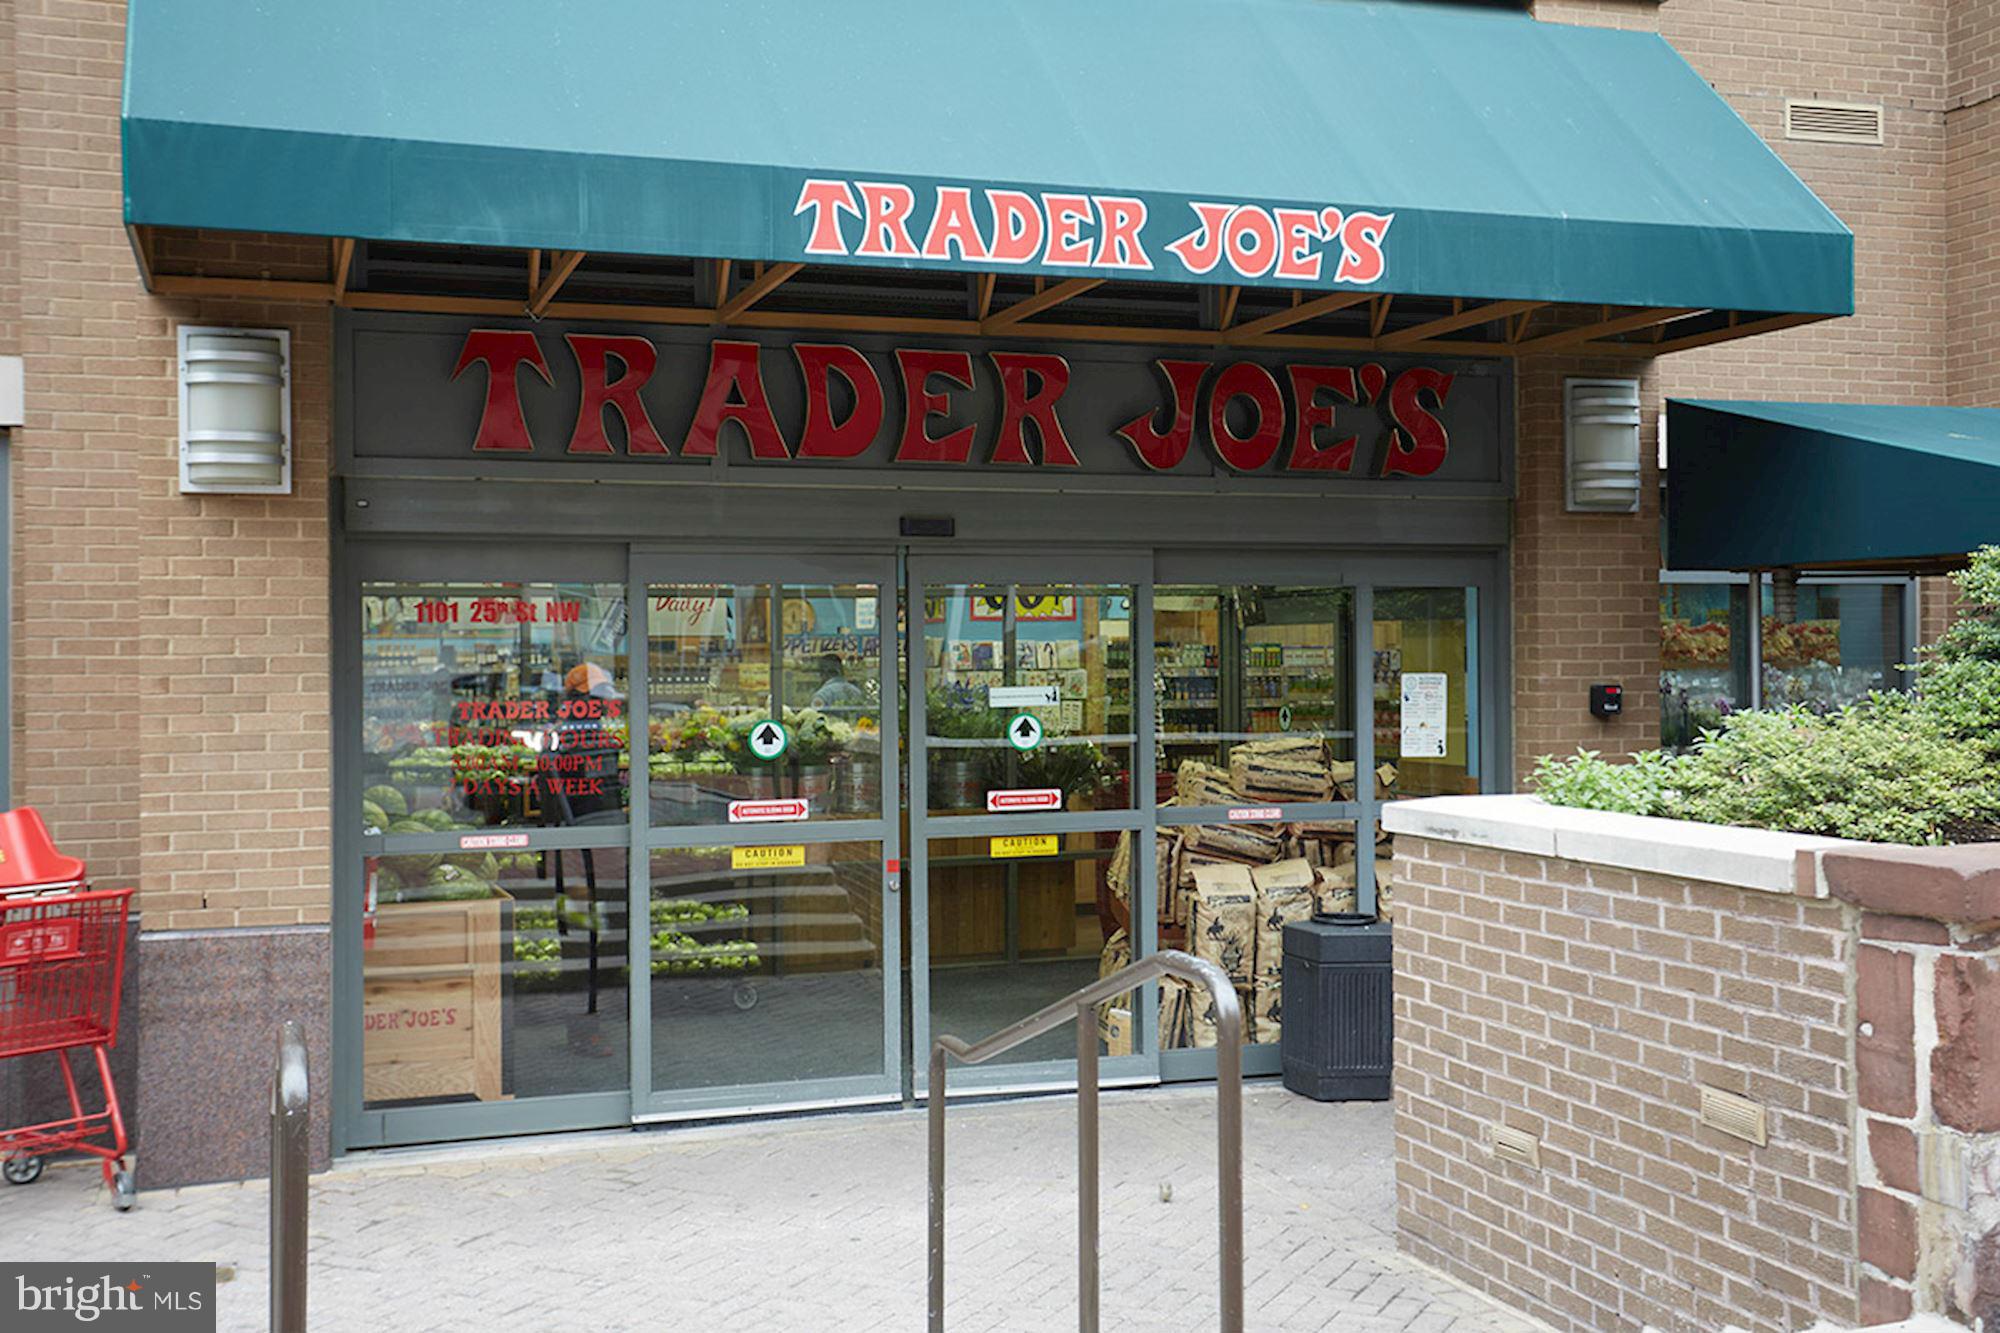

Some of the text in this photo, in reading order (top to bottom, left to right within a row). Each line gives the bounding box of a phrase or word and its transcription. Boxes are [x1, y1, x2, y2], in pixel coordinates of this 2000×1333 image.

[794, 178, 1395, 285] TRADER JOE'S
[450, 328, 1456, 479] TRADER JOE'S
[414, 601, 458, 624] 1101
[515, 601, 538, 623] St
[546, 601, 581, 623] NW
[783, 636, 857, 657] PPETIZERS
[457, 699, 623, 720] TRADER JOE'S
[463, 777, 522, 796] DAYS
[546, 777, 605, 796] WEEK
[1003, 838, 1047, 847] CAUTION
[745, 849, 793, 858] CAUTION
[364, 1007, 457, 1031] DER JOE'S
